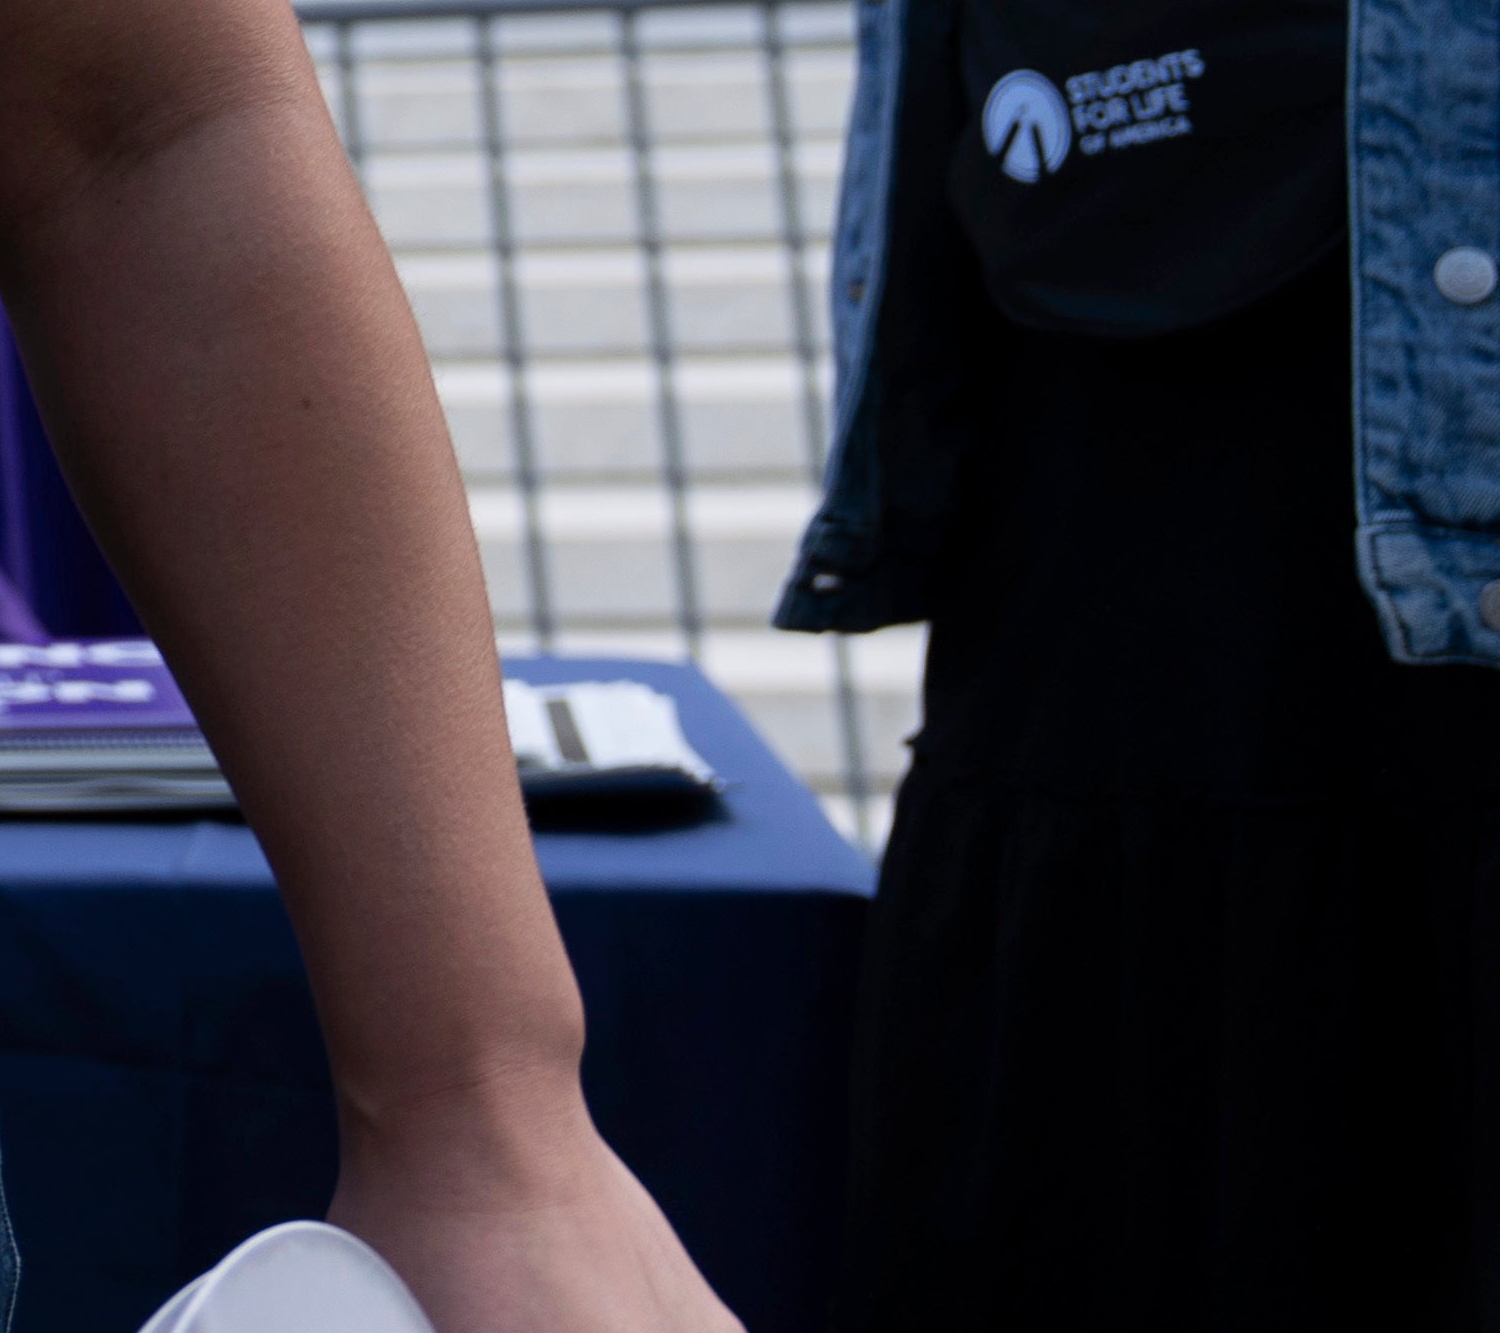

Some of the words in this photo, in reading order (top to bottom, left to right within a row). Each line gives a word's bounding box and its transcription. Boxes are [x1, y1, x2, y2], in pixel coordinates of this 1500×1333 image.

[1065, 48, 1206, 103] STUDENTS
[1072, 96, 1132, 133] FOR
[1130, 82, 1191, 121] LIFE
